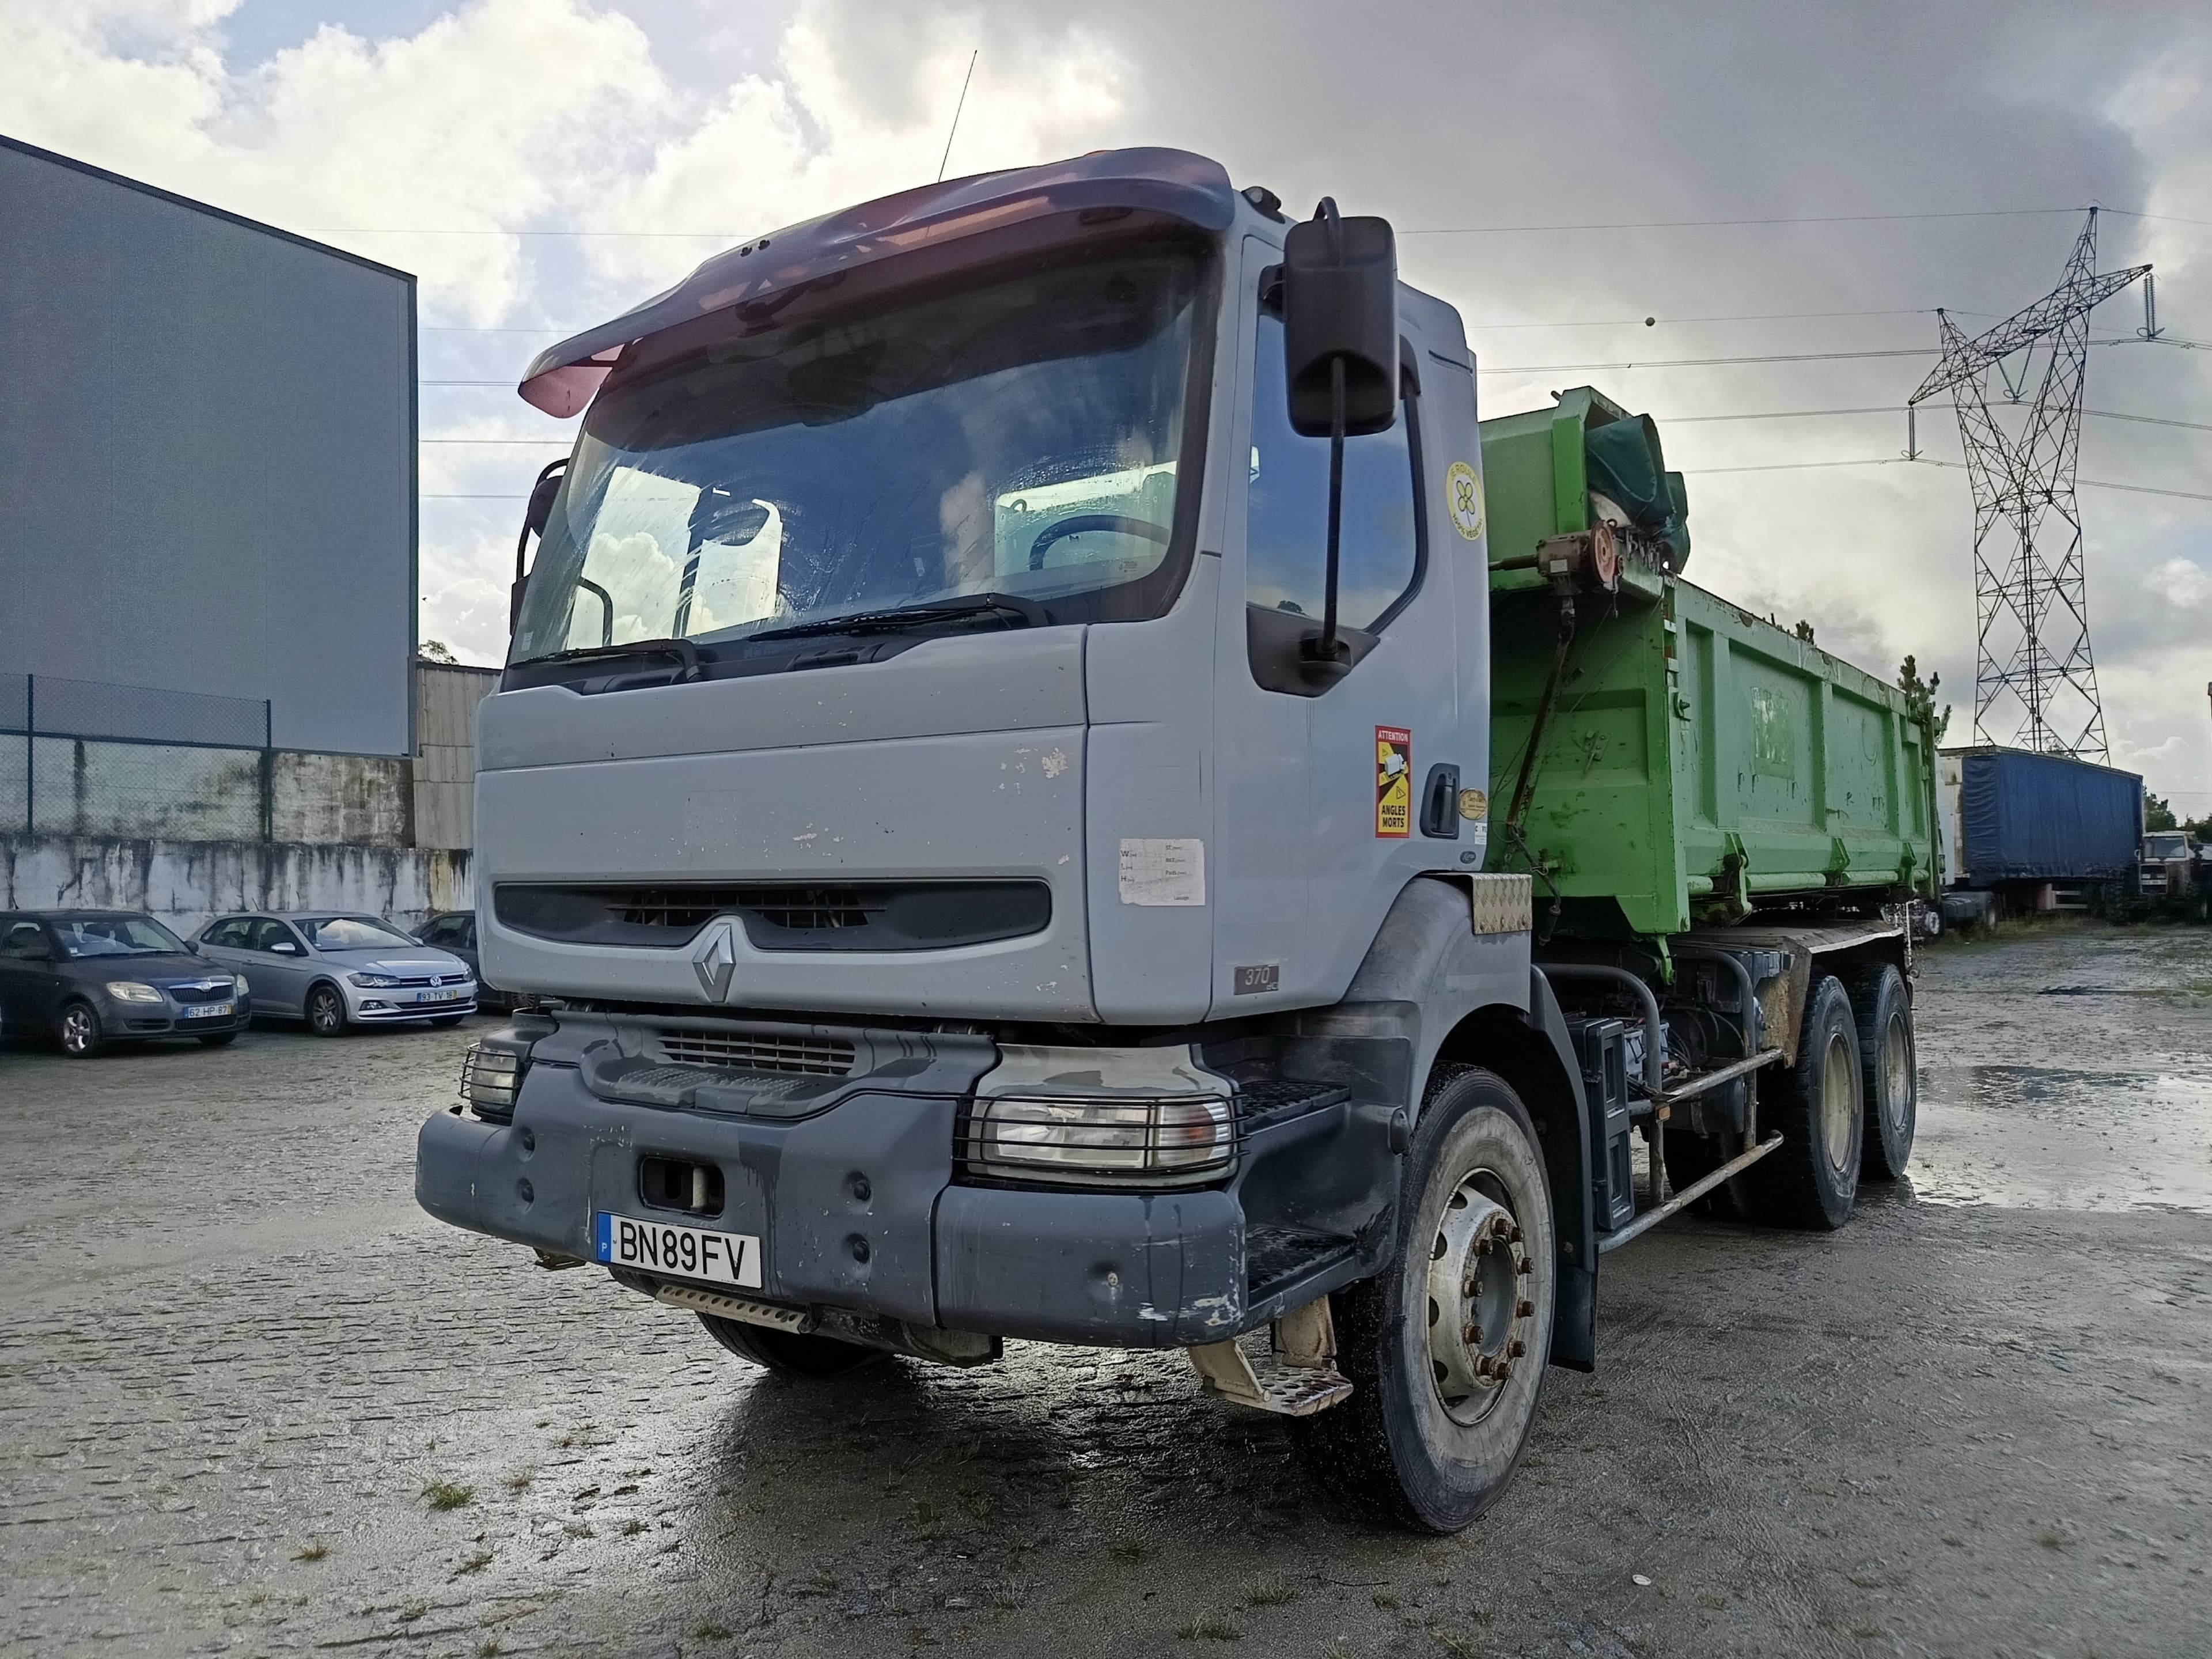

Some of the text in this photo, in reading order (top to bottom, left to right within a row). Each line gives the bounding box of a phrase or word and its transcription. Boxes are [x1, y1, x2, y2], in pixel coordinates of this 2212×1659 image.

[1378, 730, 1408, 742] ATTENTION
[1381, 805, 1406, 816] ANGLES
[1382, 818, 1404, 828] MORTS
[1245, 967, 1270, 986] 370
[601, 1221, 745, 1280] P BN89FV
